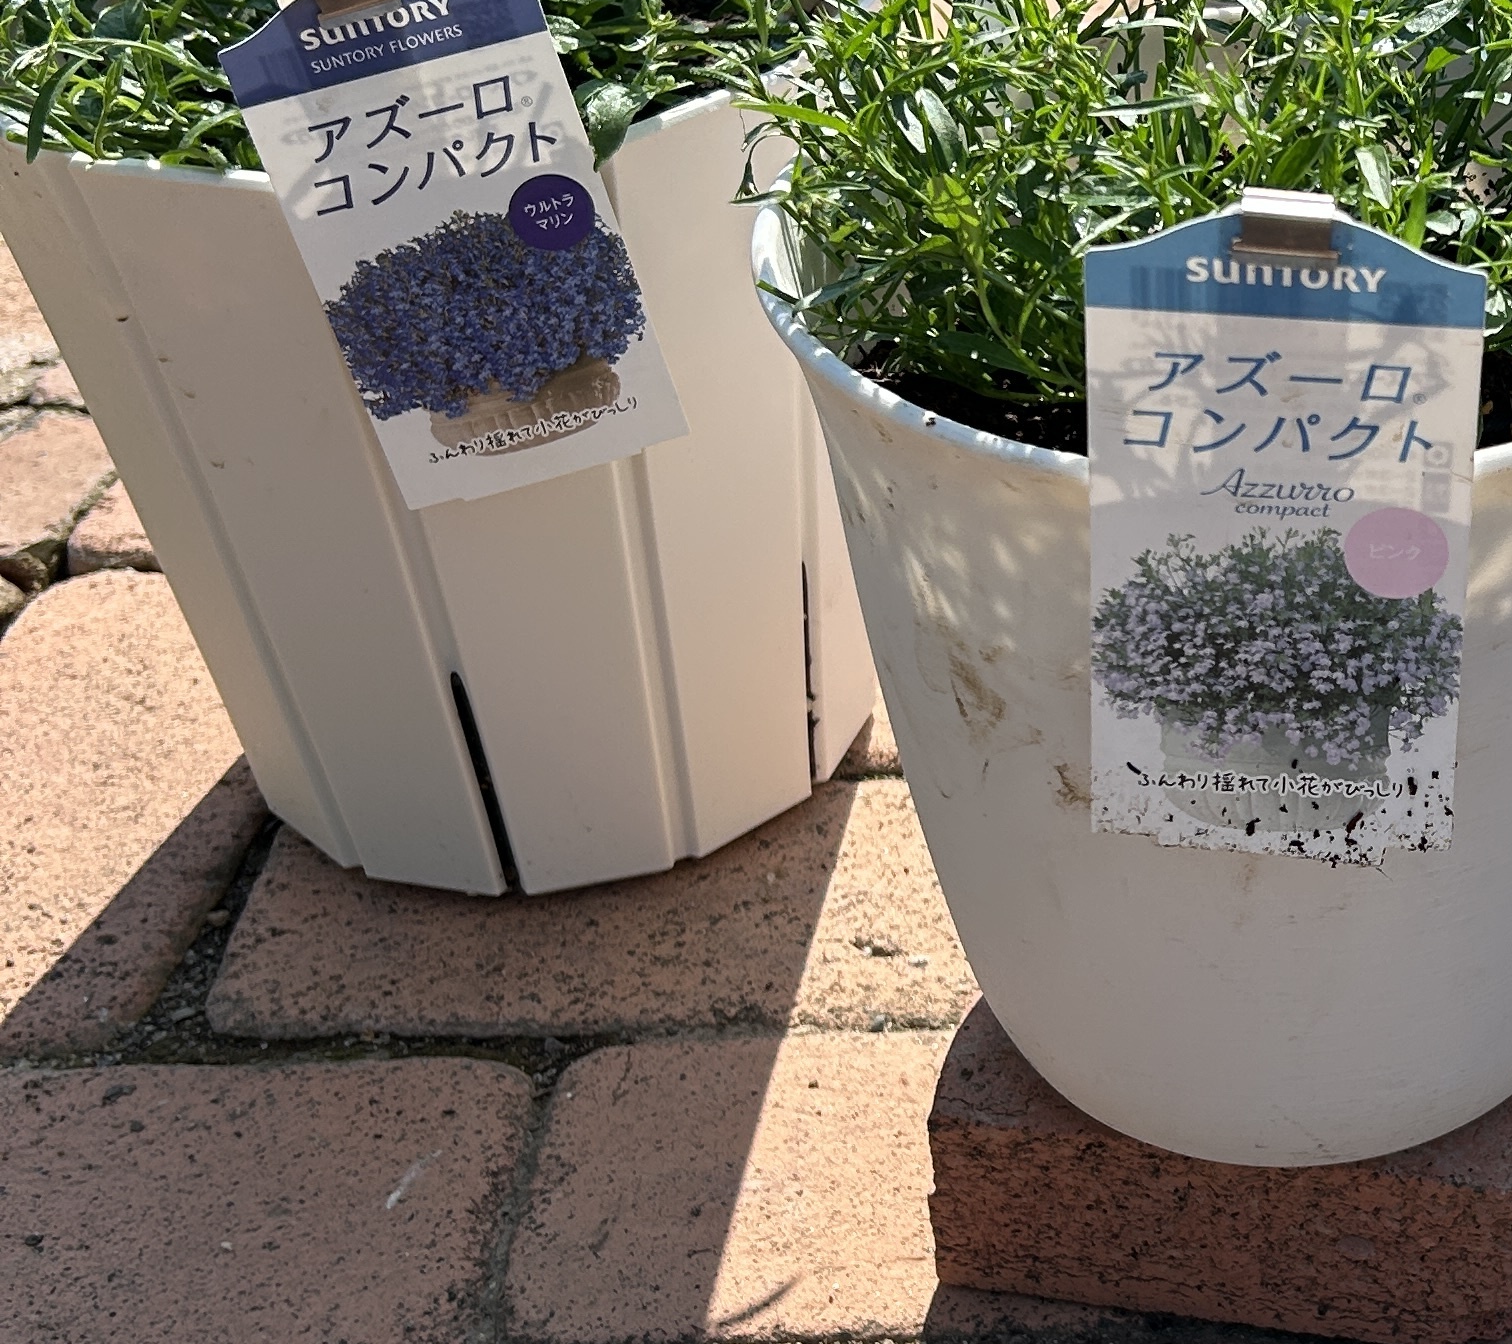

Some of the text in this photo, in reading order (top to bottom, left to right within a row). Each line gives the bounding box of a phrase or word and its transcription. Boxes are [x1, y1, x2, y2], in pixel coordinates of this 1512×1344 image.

[311, 24, 463, 74] SUNTORY FLOWERS
[314, 121, 557, 216] コンパクト
[523, 193, 574, 217] ウルトラ
[535, 213, 574, 230] マリン
[429, 397, 638, 463] ふんわり揺れて小花がびっしり
[1123, 409, 1433, 463] コンパクト
[1200, 467, 1355, 503] Azzurro
[1234, 502, 1331, 521] compact
[1138, 772, 1403, 798] ふんわり揺れて小花がびっしり
